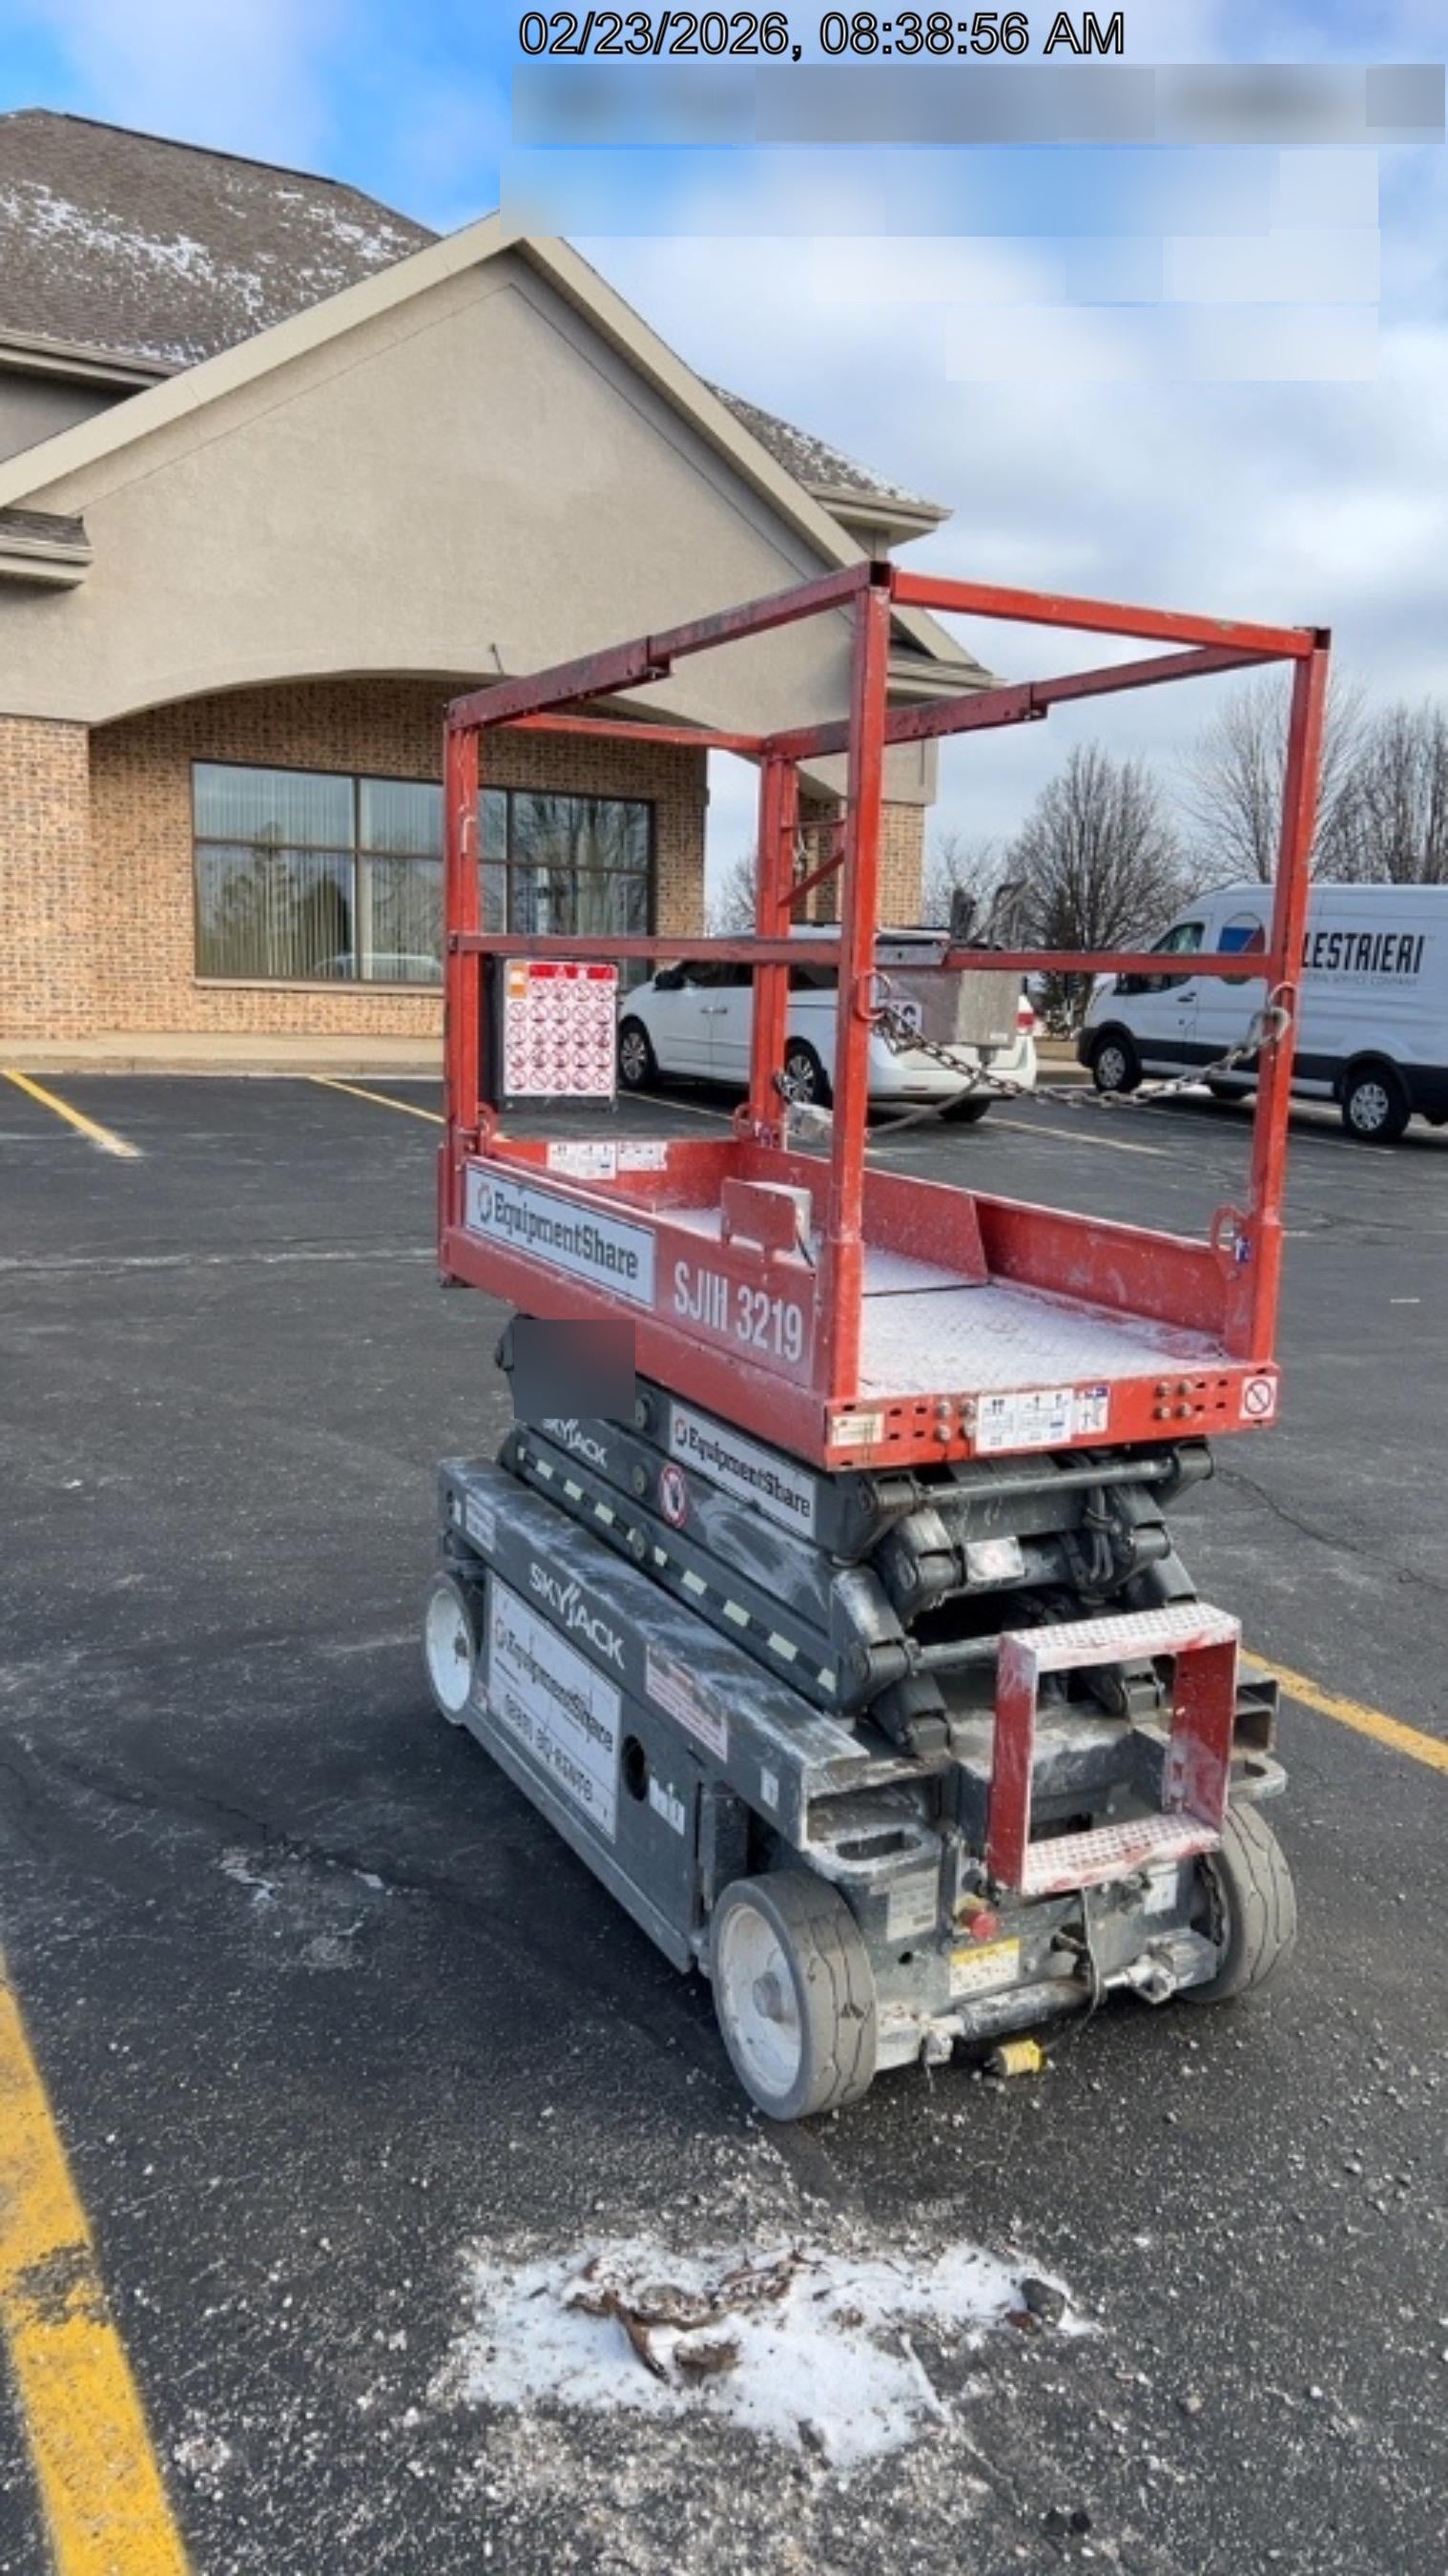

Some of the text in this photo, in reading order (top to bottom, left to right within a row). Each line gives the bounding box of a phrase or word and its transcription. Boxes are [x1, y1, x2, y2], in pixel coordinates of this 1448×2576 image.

[1300, 931, 1426, 974] LESTRIERI
[494, 1190, 639, 1280] EquipmentShare
[736, 1284, 803, 1361] 3219
[689, 1426, 810, 1518] EquipmentShare
[528, 1562, 625, 1670] SKYJACK
